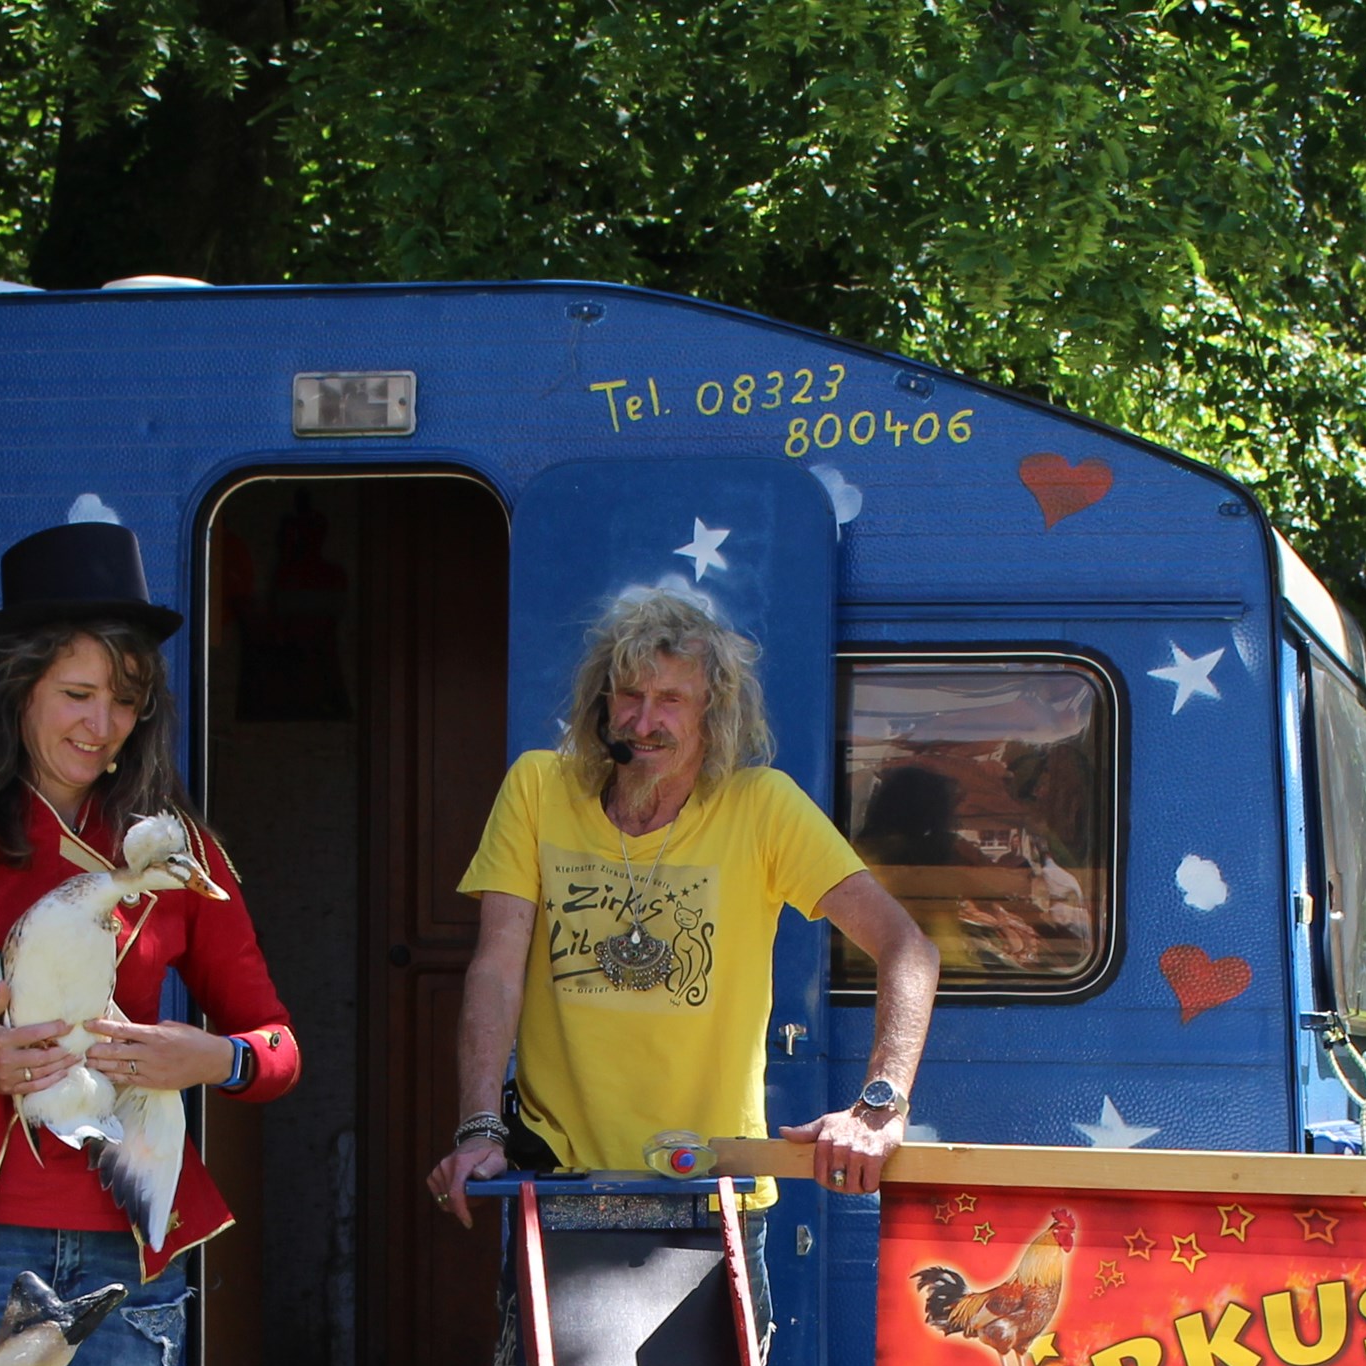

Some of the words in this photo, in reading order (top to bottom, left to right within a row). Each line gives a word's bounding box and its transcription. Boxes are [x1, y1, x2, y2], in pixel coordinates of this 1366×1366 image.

[589, 377, 671, 432] Tel.
[696, 364, 846, 416] 08323
[784, 408, 974, 458] 800406
[562, 882, 663, 923] Zirkus
